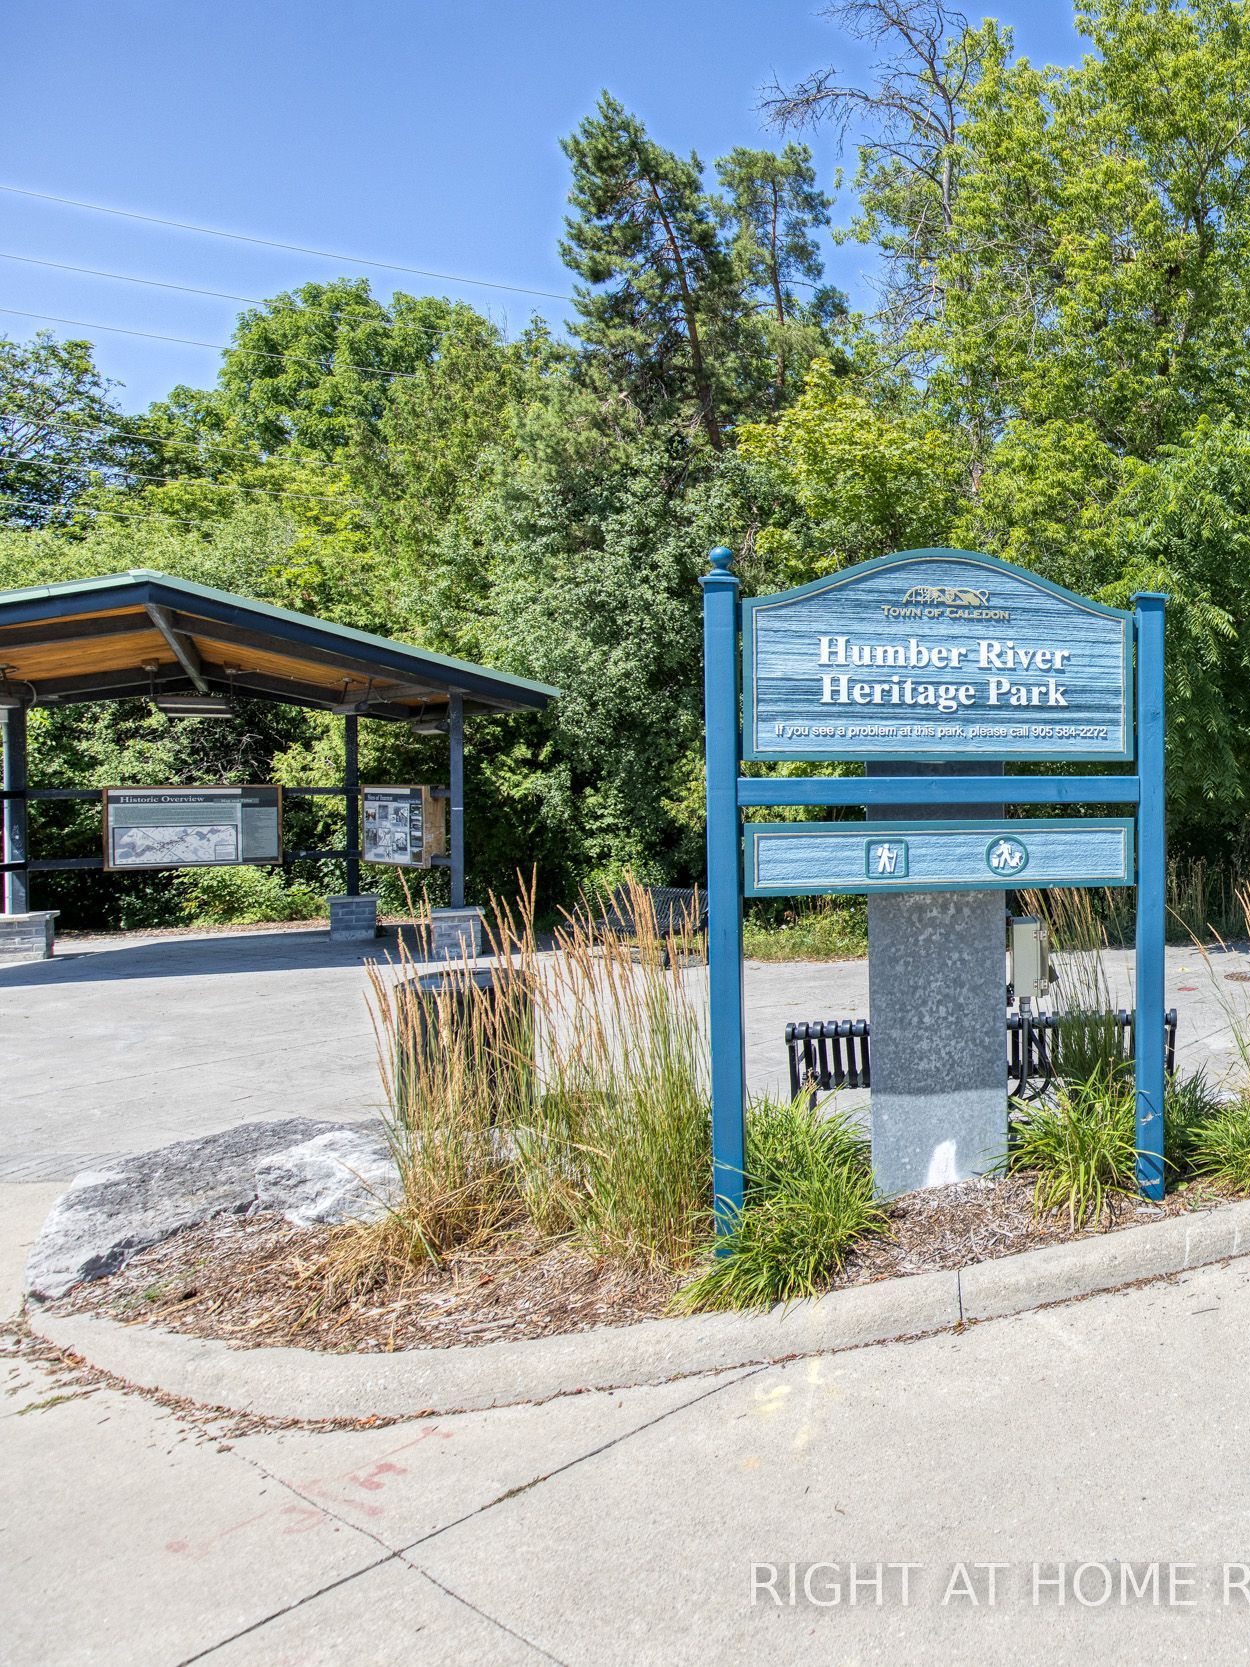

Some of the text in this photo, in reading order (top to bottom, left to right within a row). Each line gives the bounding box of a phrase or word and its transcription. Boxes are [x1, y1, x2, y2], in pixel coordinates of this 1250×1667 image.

[925, 608, 943, 618] OF
[946, 608, 1010, 620] CALEDON
[817, 636, 1070, 670] Humber River
[818, 674, 1069, 713] Heritage Park
[776, 724, 1107, 739] If you see a problem at this park, please call 905 584-2272
[120, 795, 205, 804] Historic Overview
